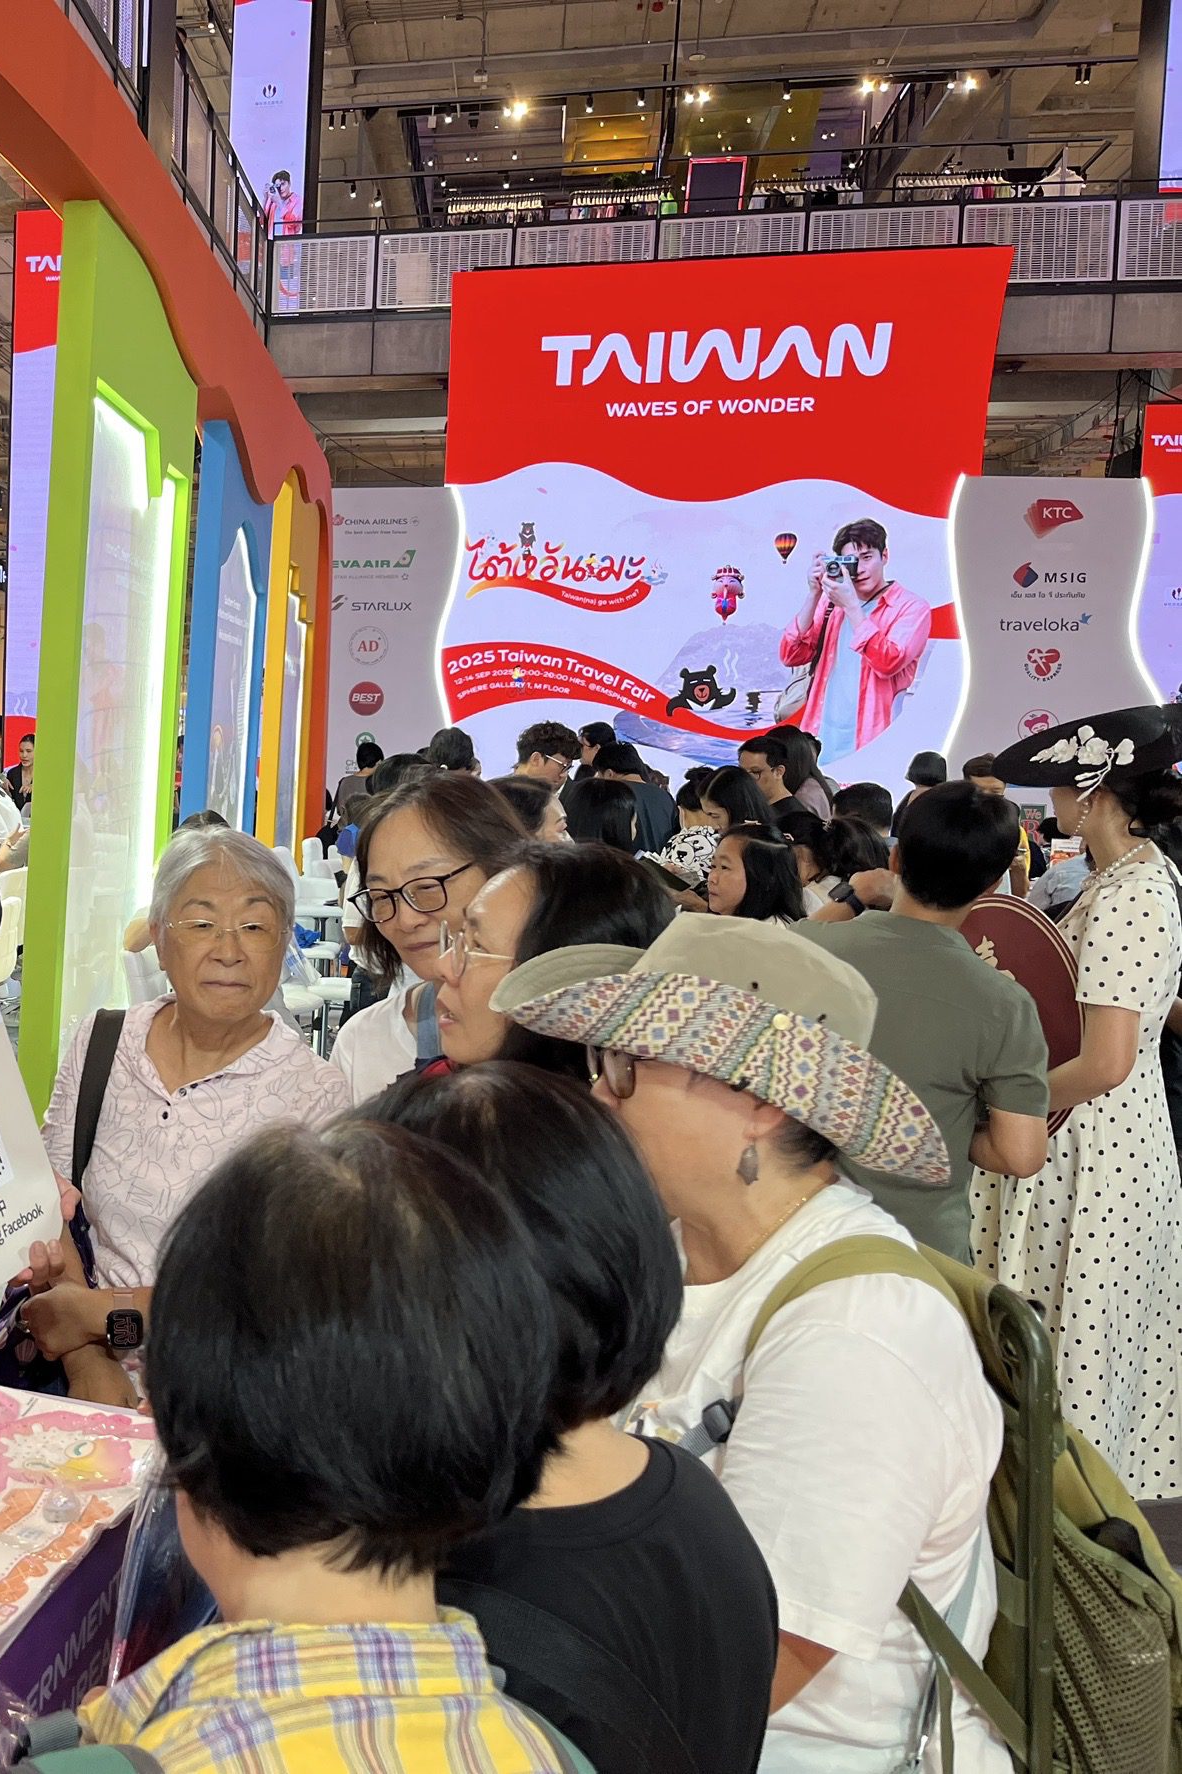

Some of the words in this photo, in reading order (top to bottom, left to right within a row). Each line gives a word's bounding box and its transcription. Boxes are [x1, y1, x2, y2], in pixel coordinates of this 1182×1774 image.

[541, 322, 893, 386] TAIWAN
[605, 401, 678, 417] WAVES
[682, 400, 713, 415] OF
[717, 397, 815, 414] WONDER
[1151, 434, 1182, 446] TAI
[1043, 507, 1072, 518] KTC
[332, 560, 361, 568] EVA
[362, 560, 390, 568] AIR
[1044, 572, 1086, 583] MSIG
[561, 590, 597, 605] Taiwan(na)
[598, 599, 607, 607] go
[608, 597, 625, 605] with
[625, 589, 639, 601] me?
[351, 602, 412, 611] STARLUX
[999, 617, 1080, 632] traveloka
[357, 640, 379, 652] AD
[446, 650, 496, 675] 2025
[497, 649, 563, 670] Taiwan
[565, 657, 620, 687] Travel
[620, 677, 656, 703] Fair
[1024, 663, 1041, 682] QUALITY
[1042, 663, 1063, 682] EXPRESS
[456, 683, 489, 700] SPHERE
[489, 681, 526, 690] GALLERY
[543, 684, 571, 695] FLOOR
[475, 671, 491, 680] SEP
[492, 669, 513, 677] 2025
[516, 668, 568, 681] 0:00-20:00
[569, 676, 587, 688] HRS.
[587, 682, 638, 709] @EMSPHERE
[351, 693, 381, 702] BEST
[1024, 808, 1042, 819] We
[2, 1203, 45, 1238] Facebook
